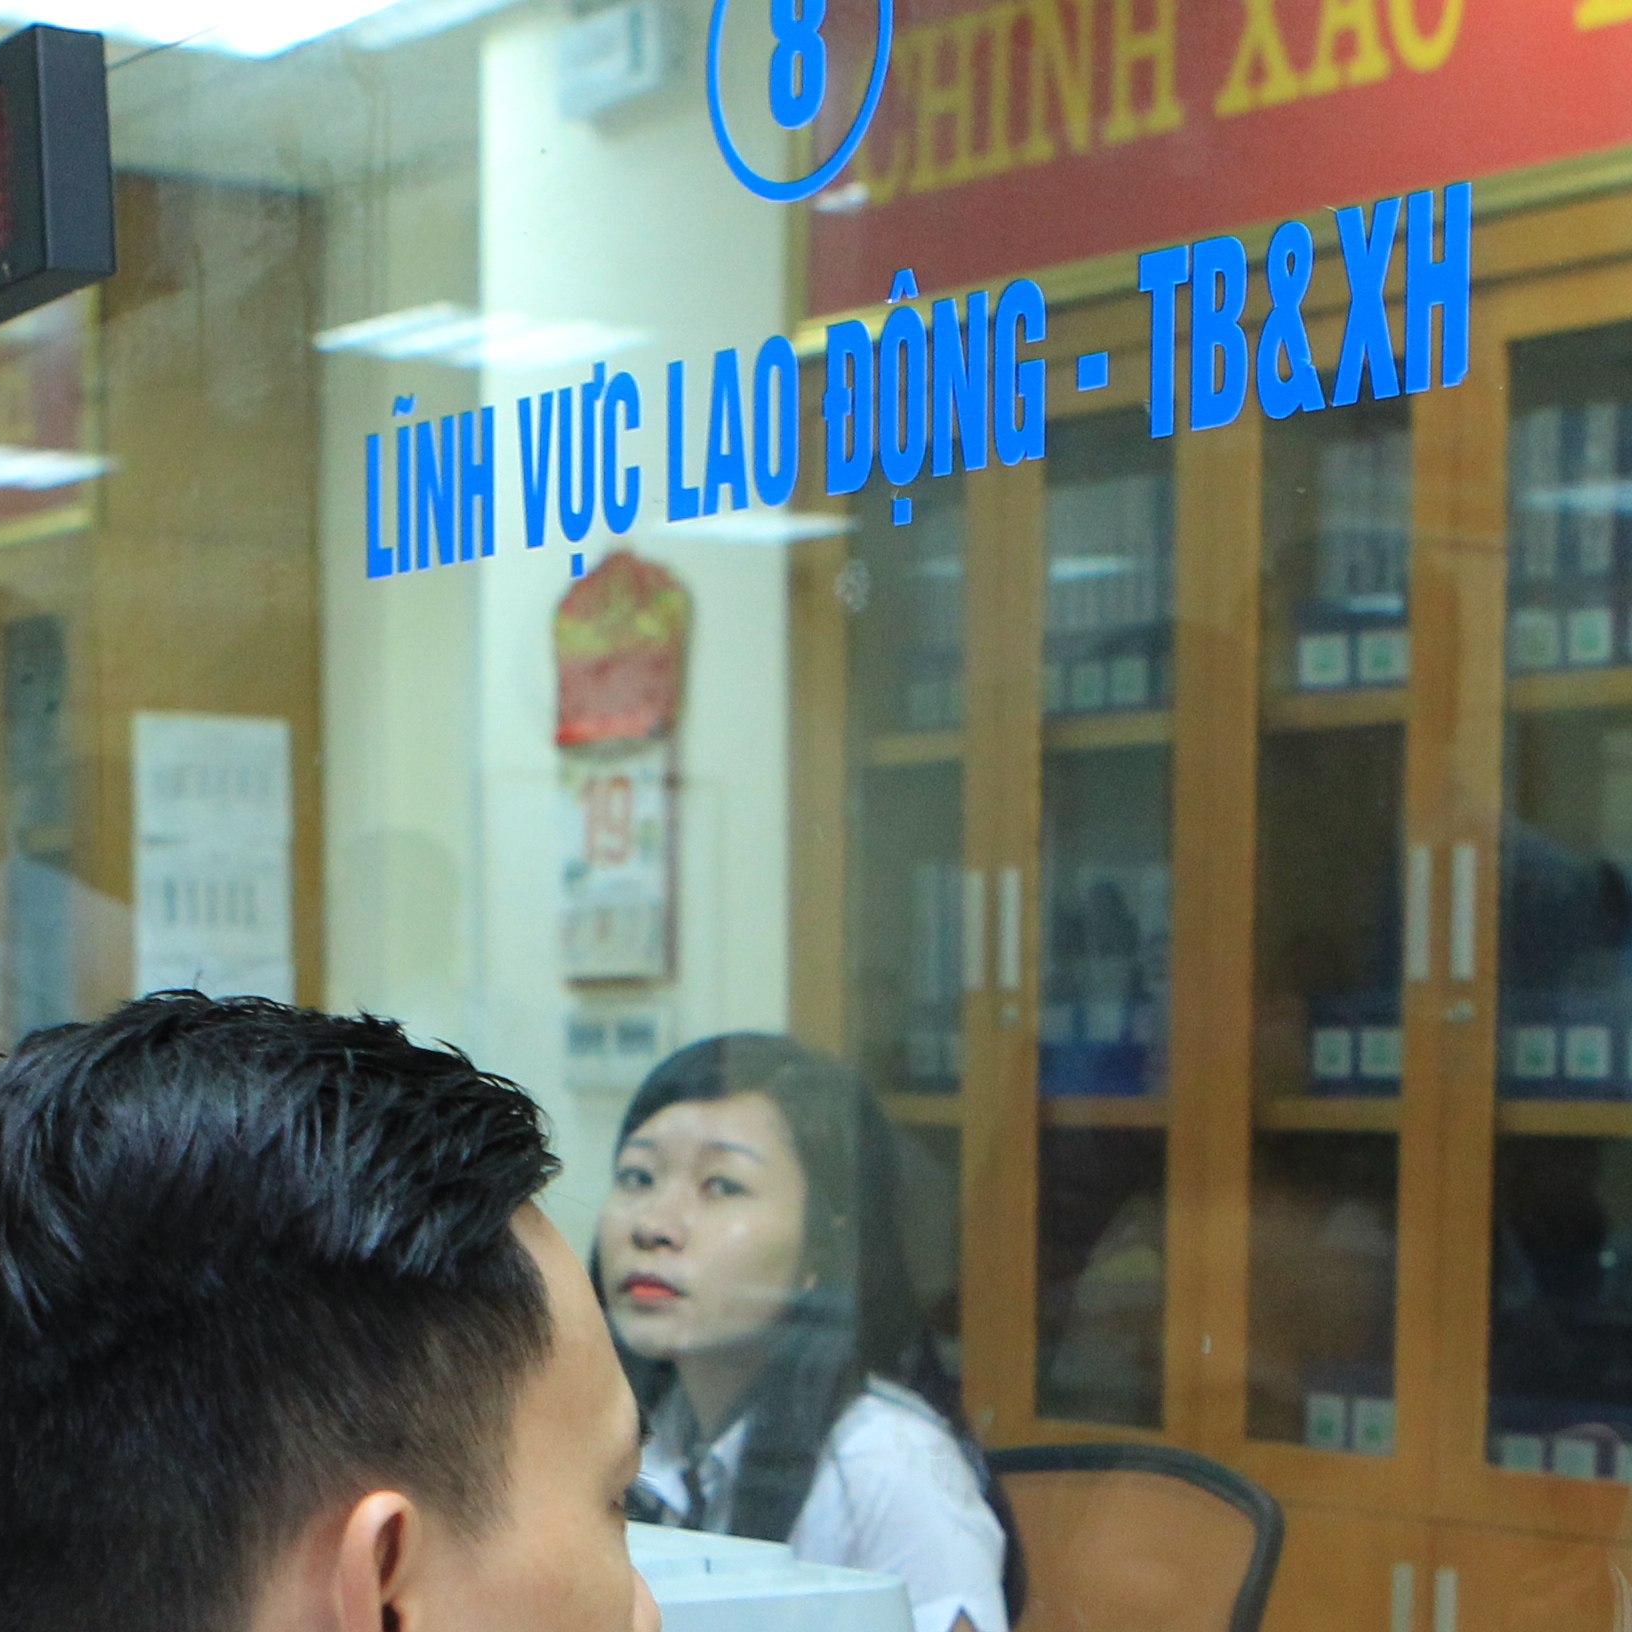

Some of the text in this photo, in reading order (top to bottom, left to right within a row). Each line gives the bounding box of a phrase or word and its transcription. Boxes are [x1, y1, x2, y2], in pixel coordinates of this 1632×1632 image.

[769, 0, 826, 131] 8
[365, 182, 1473, 580] LĨNH VỰC LAO ĐỘNG - TB&XH
